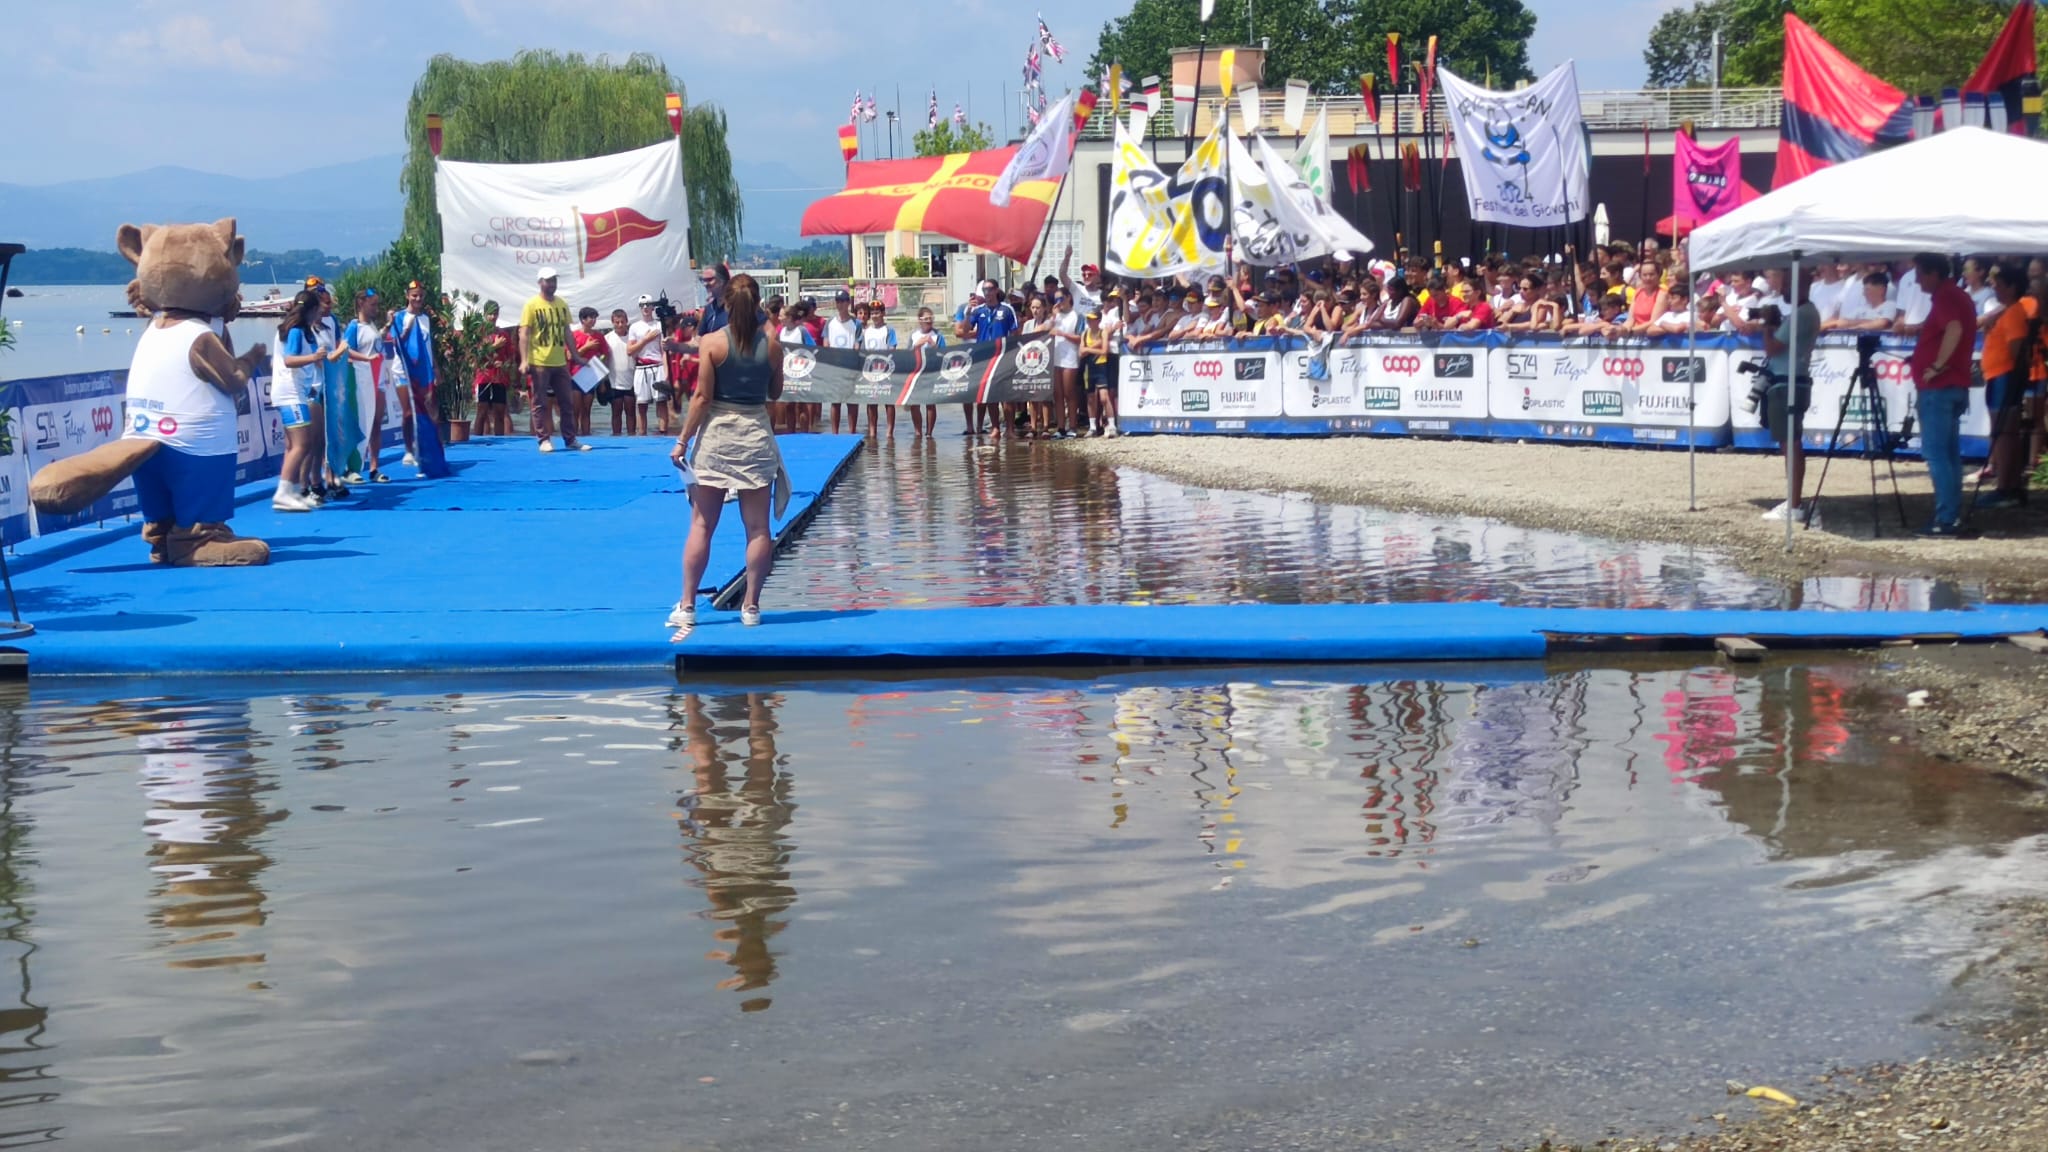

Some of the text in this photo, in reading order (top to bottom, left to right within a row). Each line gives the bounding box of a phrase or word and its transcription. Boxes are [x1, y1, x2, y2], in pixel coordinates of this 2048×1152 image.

[1531, 199, 1580, 218] Giovani
[489, 216, 564, 232] CIRCOLO
[471, 233, 566, 248] CANOTTIERI
[515, 250, 569, 265] ROMA
[1193, 360, 1223, 381] coop
[1382, 355, 1421, 377] coop
[1602, 356, 1645, 382] coop
[1220, 391, 1257, 403] FUJIFILM
[1414, 389, 1463, 402] FUJIFILM
[1584, 392, 1621, 405] ULIVETO
[1638, 394, 1691, 409] FUJIFILM
[91, 405, 114, 438] coop
